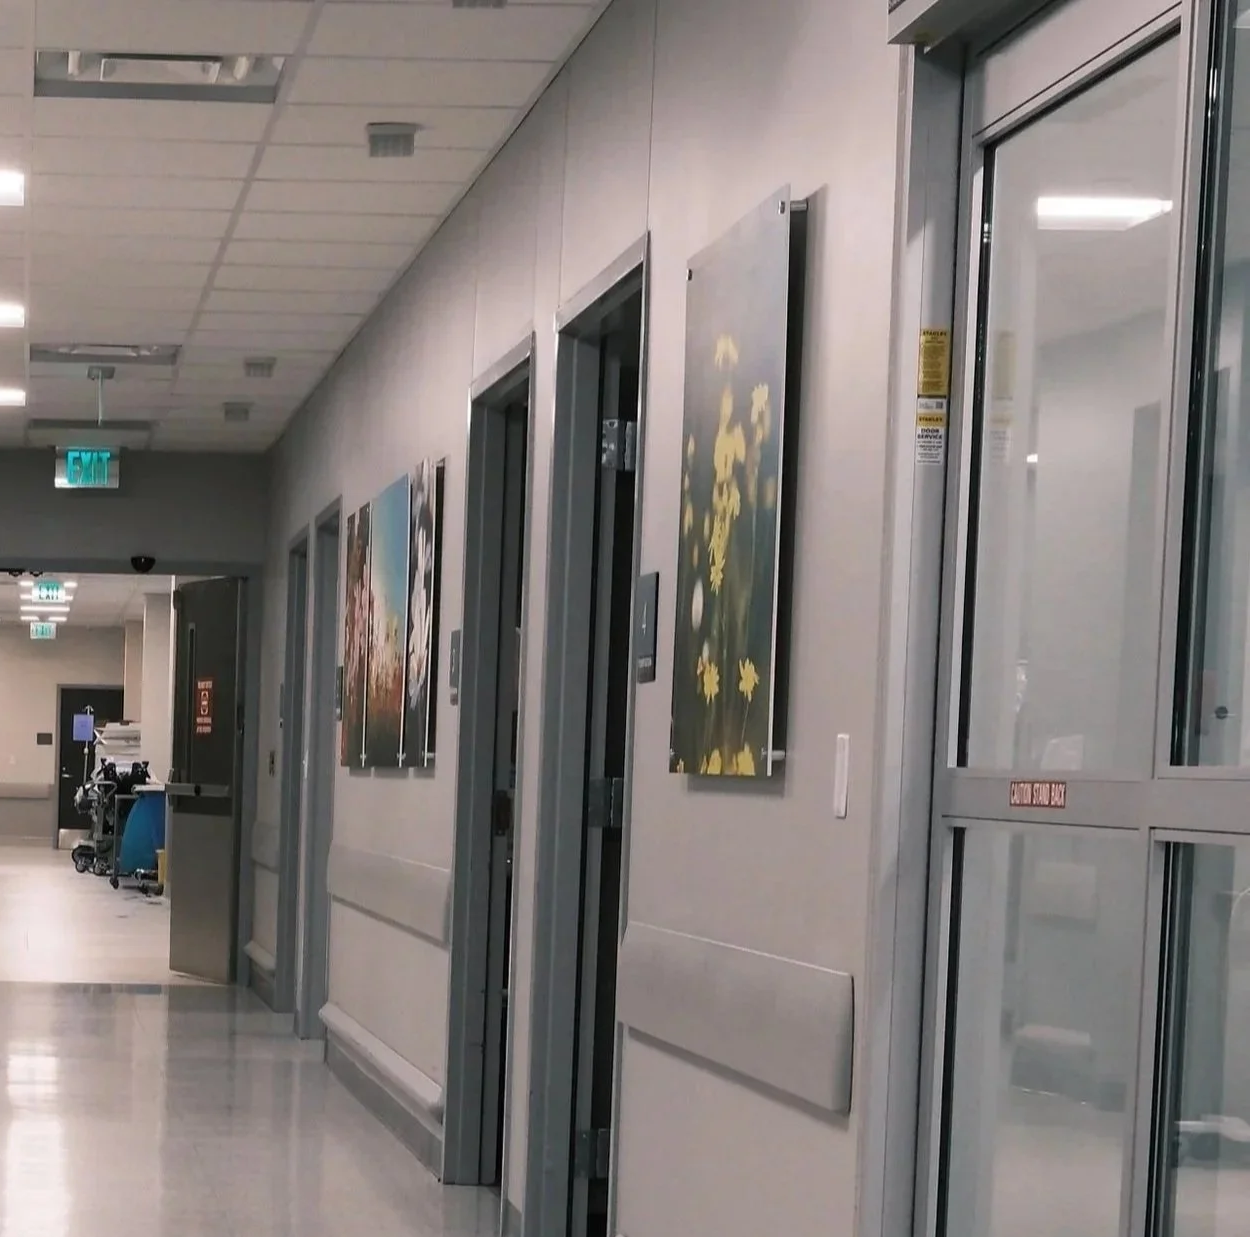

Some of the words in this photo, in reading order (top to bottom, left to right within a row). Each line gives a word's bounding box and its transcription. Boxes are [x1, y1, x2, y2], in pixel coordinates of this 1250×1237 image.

[67, 451, 111, 485] EXIT
[1011, 783, 1032, 804] CAUTION
[1033, 783, 1050, 805] STAND
[1051, 783, 1066, 806] BACK
